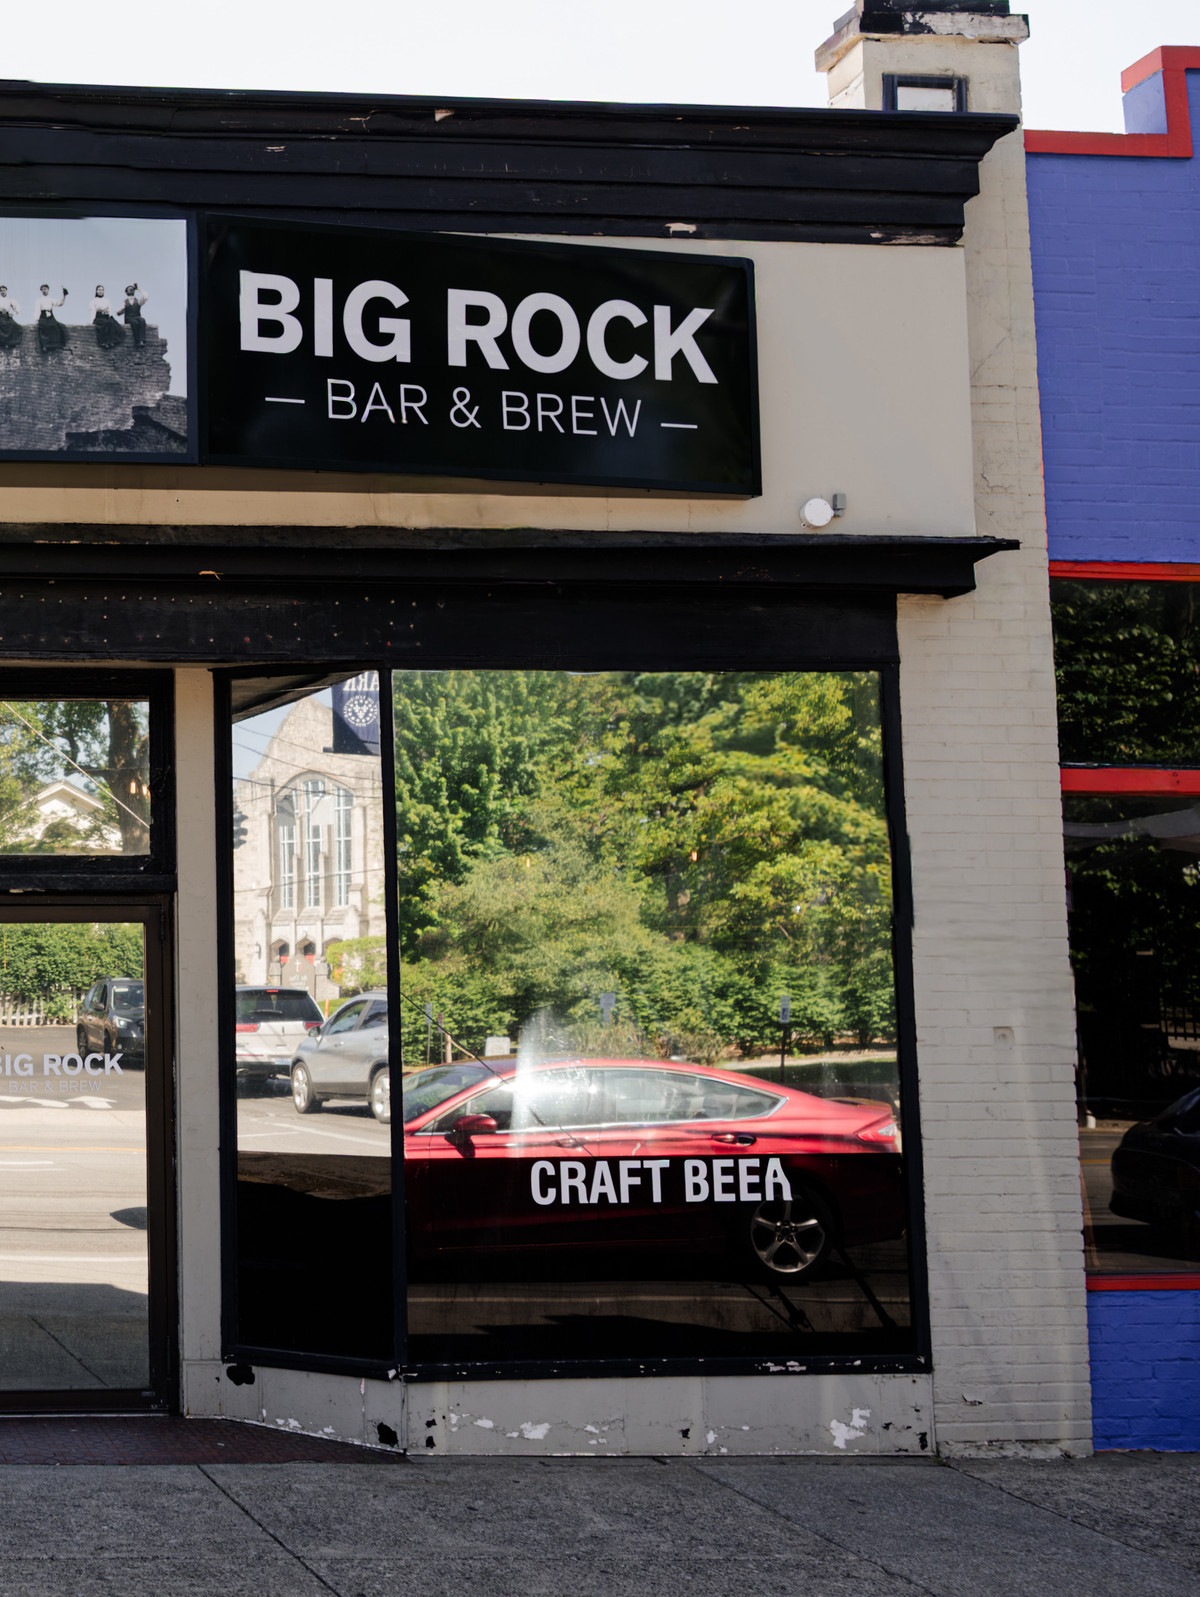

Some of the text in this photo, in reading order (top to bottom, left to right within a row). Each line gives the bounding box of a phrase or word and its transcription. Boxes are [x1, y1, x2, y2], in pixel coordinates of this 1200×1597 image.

[238, 270, 719, 384] BIG ROCK
[326, 378, 642, 438] BAR & BREW
[8, 1080, 102, 1093] BAR & BREW
[43, 1052, 124, 1077] ROCK
[530, 1160, 670, 1205] CRAFT
